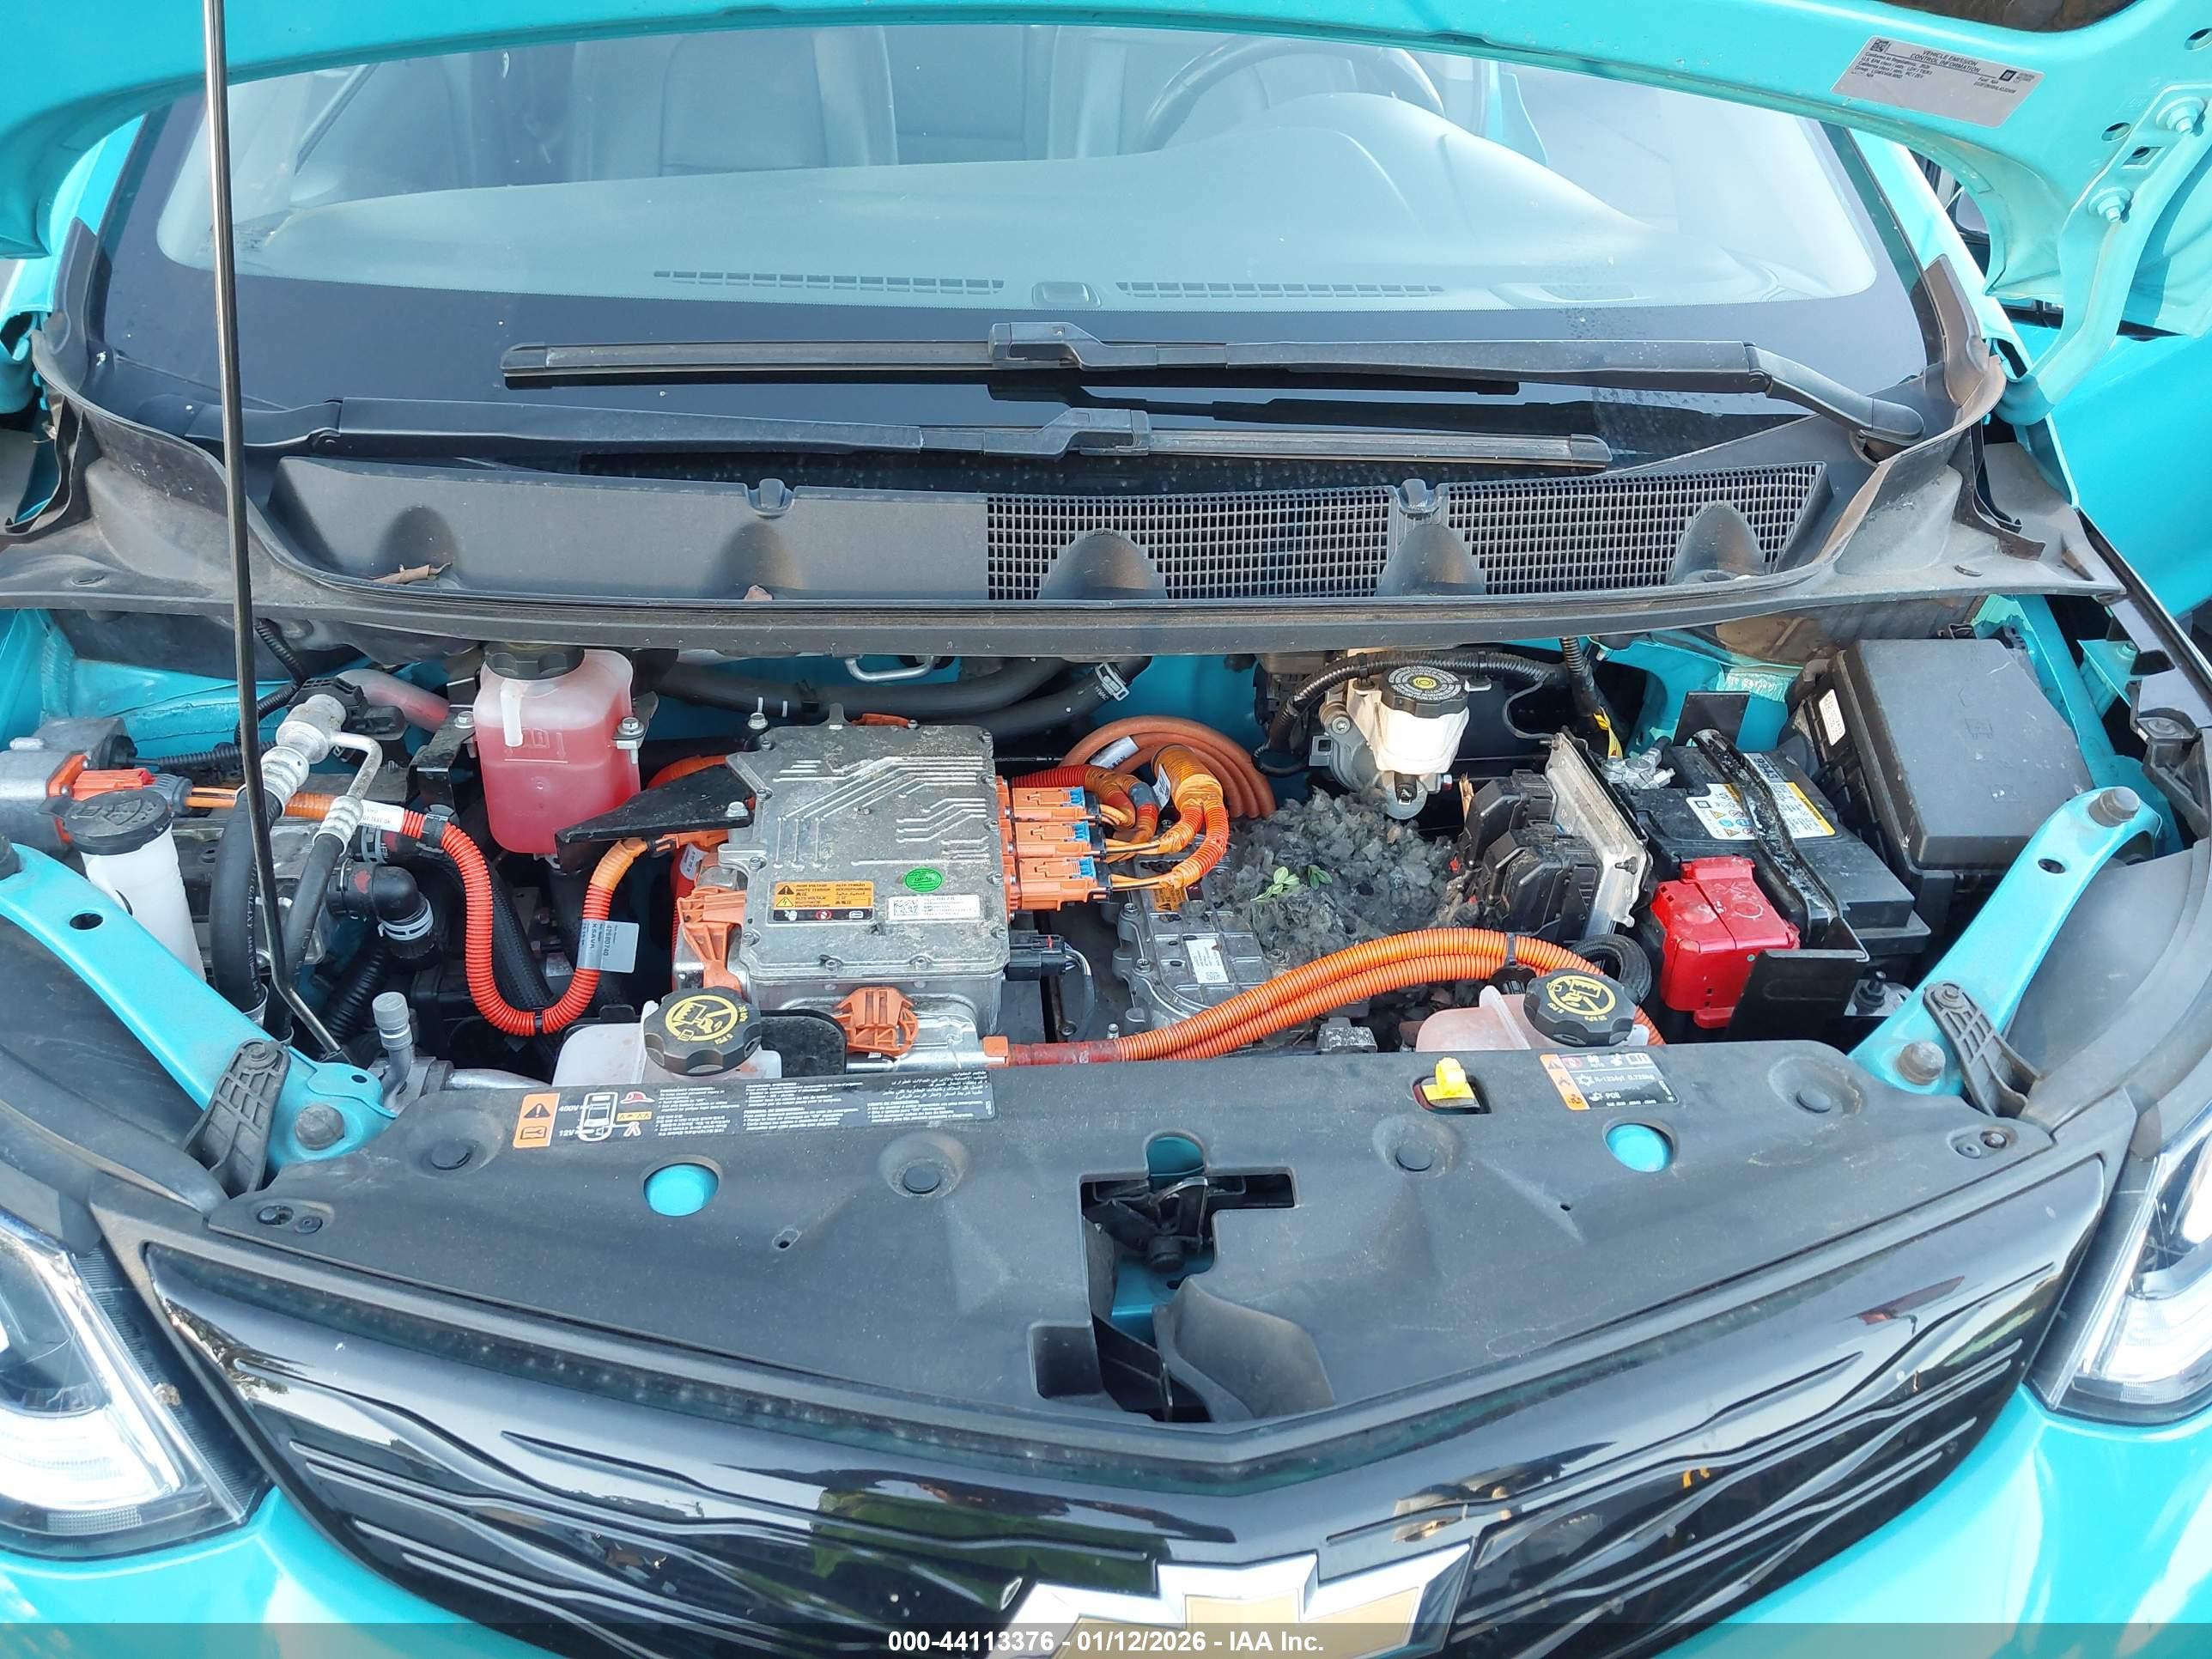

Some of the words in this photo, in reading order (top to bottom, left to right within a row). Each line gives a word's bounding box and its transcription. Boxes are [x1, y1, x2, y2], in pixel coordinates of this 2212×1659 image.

[1909, 53, 1940, 64] CONTROL
[1938, 59, 1981, 72] INFORMATION
[1922, 50, 1949, 59] VEHICLE
[1948, 56, 1978, 65] EMISSION
[246, 884, 255, 929] GALAXY
